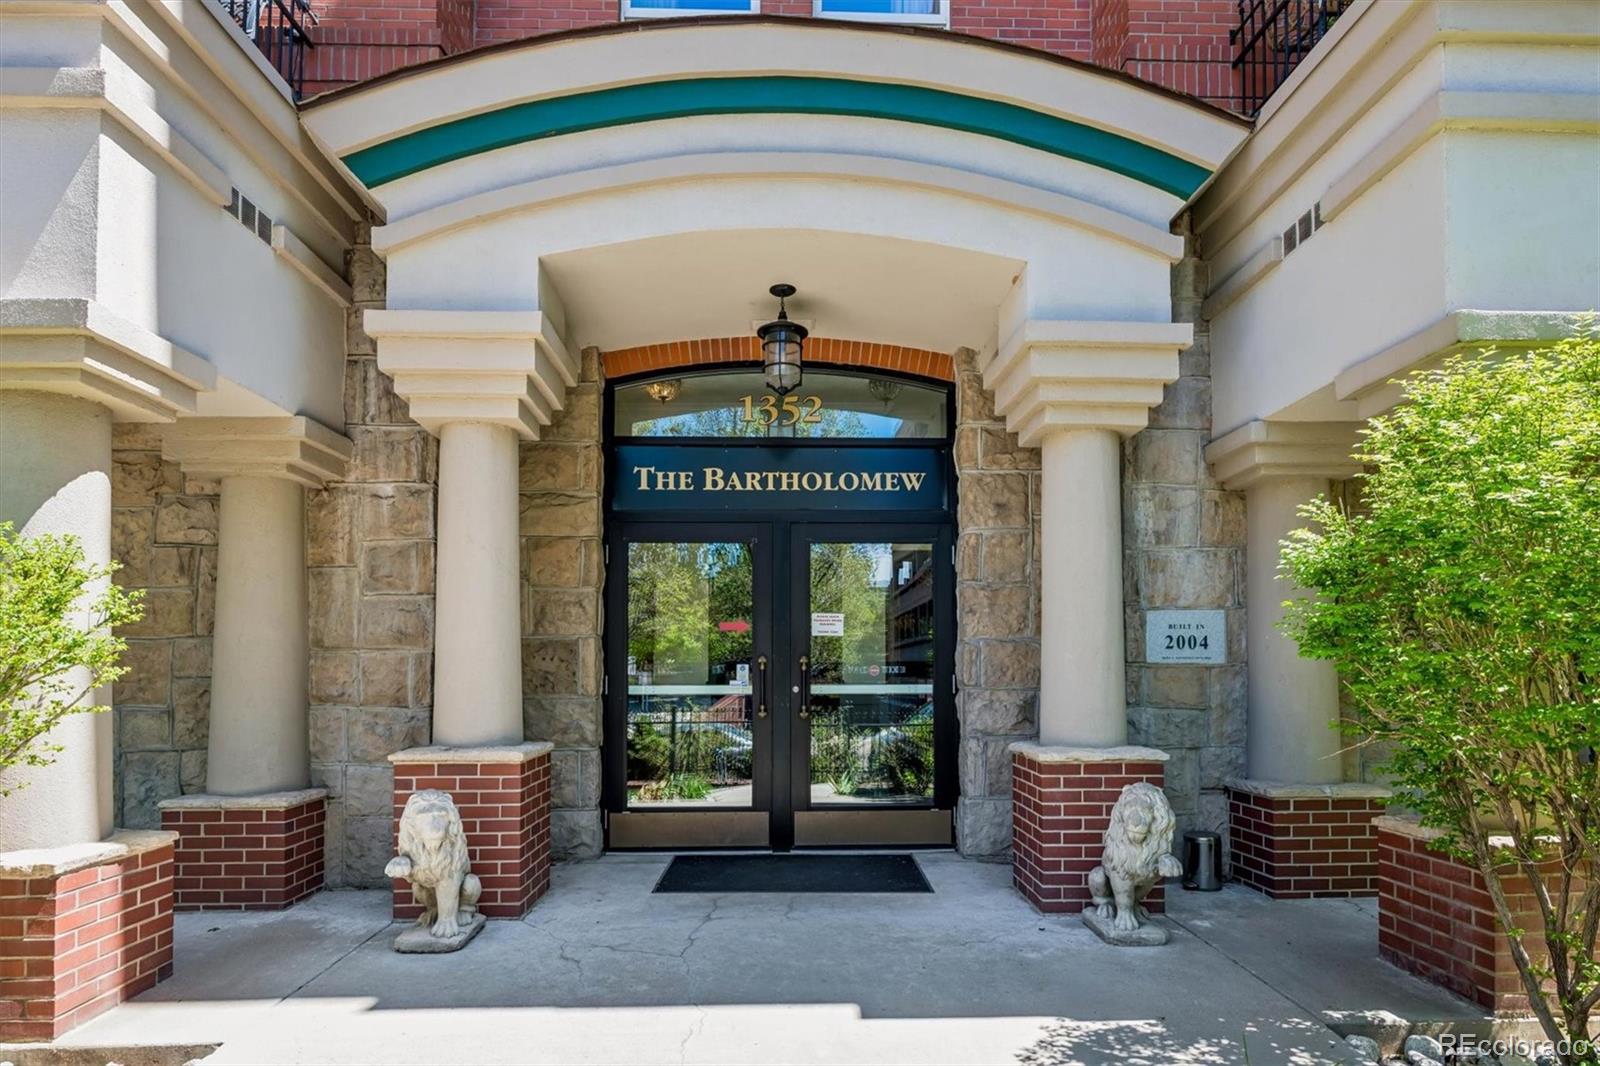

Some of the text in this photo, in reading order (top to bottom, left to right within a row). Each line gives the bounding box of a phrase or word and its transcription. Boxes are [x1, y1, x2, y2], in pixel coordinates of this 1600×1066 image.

[738, 394, 823, 426] 1352
[633, 465, 926, 492] THE BARTHOLOMEW
[1164, 634, 1209, 650] 2004
